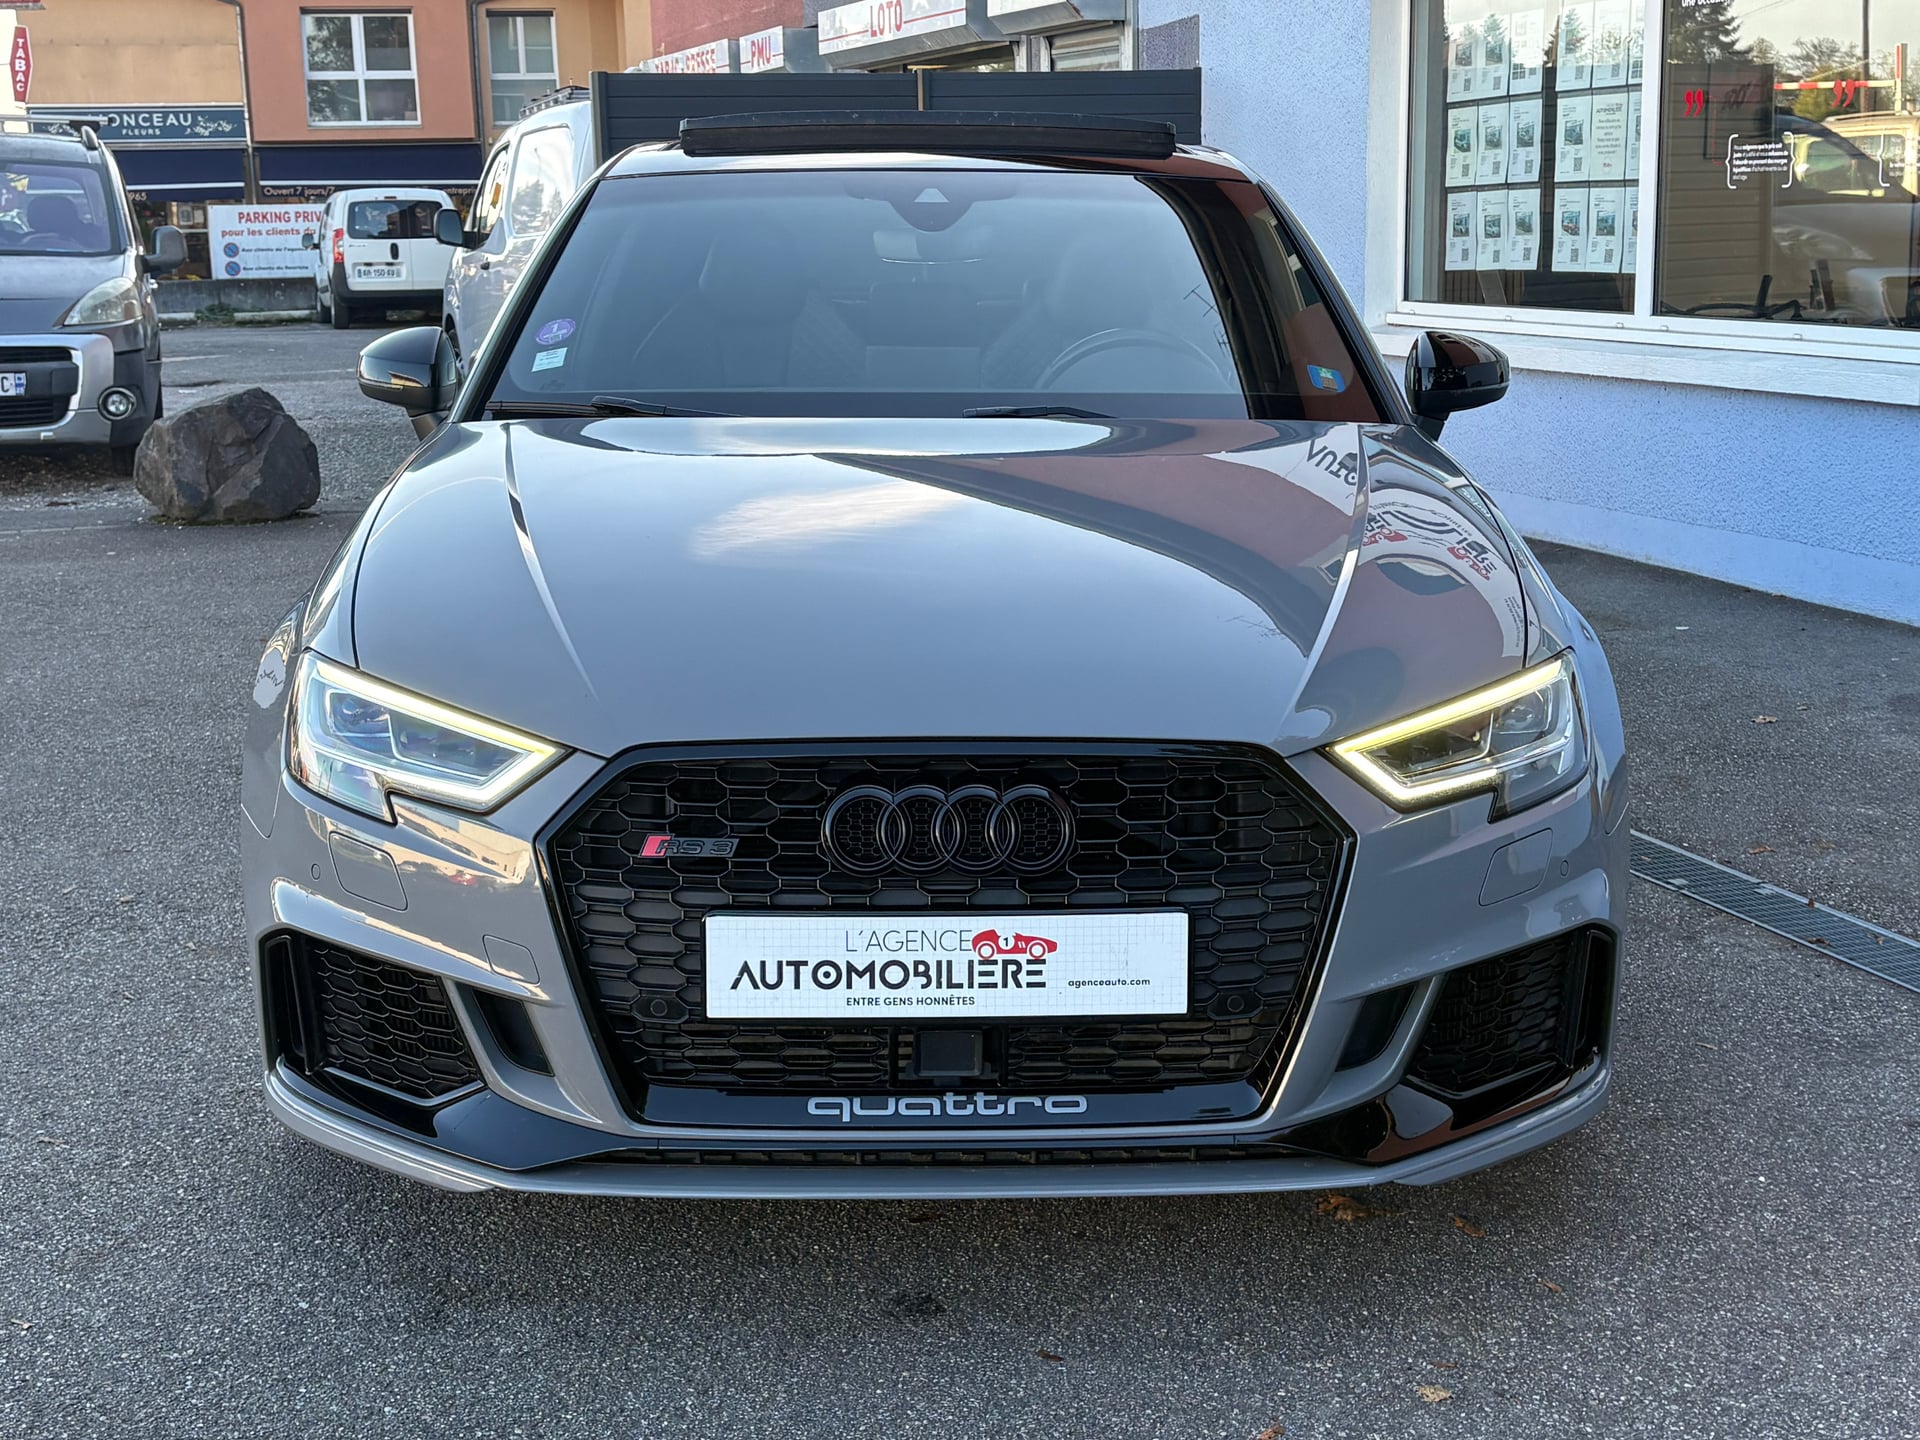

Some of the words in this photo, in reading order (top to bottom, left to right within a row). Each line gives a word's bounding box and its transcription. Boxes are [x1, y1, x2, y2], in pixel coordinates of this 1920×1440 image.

[870, 0, 902, 37] LOTO
[750, 36, 771, 68] PMU
[15, 38, 26, 92] TABAC
[90, 113, 192, 127] ONCEAU
[238, 211, 292, 224] PARKING
[222, 229, 245, 239] pour
[247, 228, 264, 237] les
[265, 227, 301, 237] clients
[845, 930, 973, 952] L'AGENCE
[1067, 978, 1151, 989] agenceauto.com
[846, 996, 881, 1006] ENTRE
[884, 996, 913, 1006] GENS
[916, 993, 976, 1006] HONNÊTES
[807, 1092, 1088, 1122] quattro
